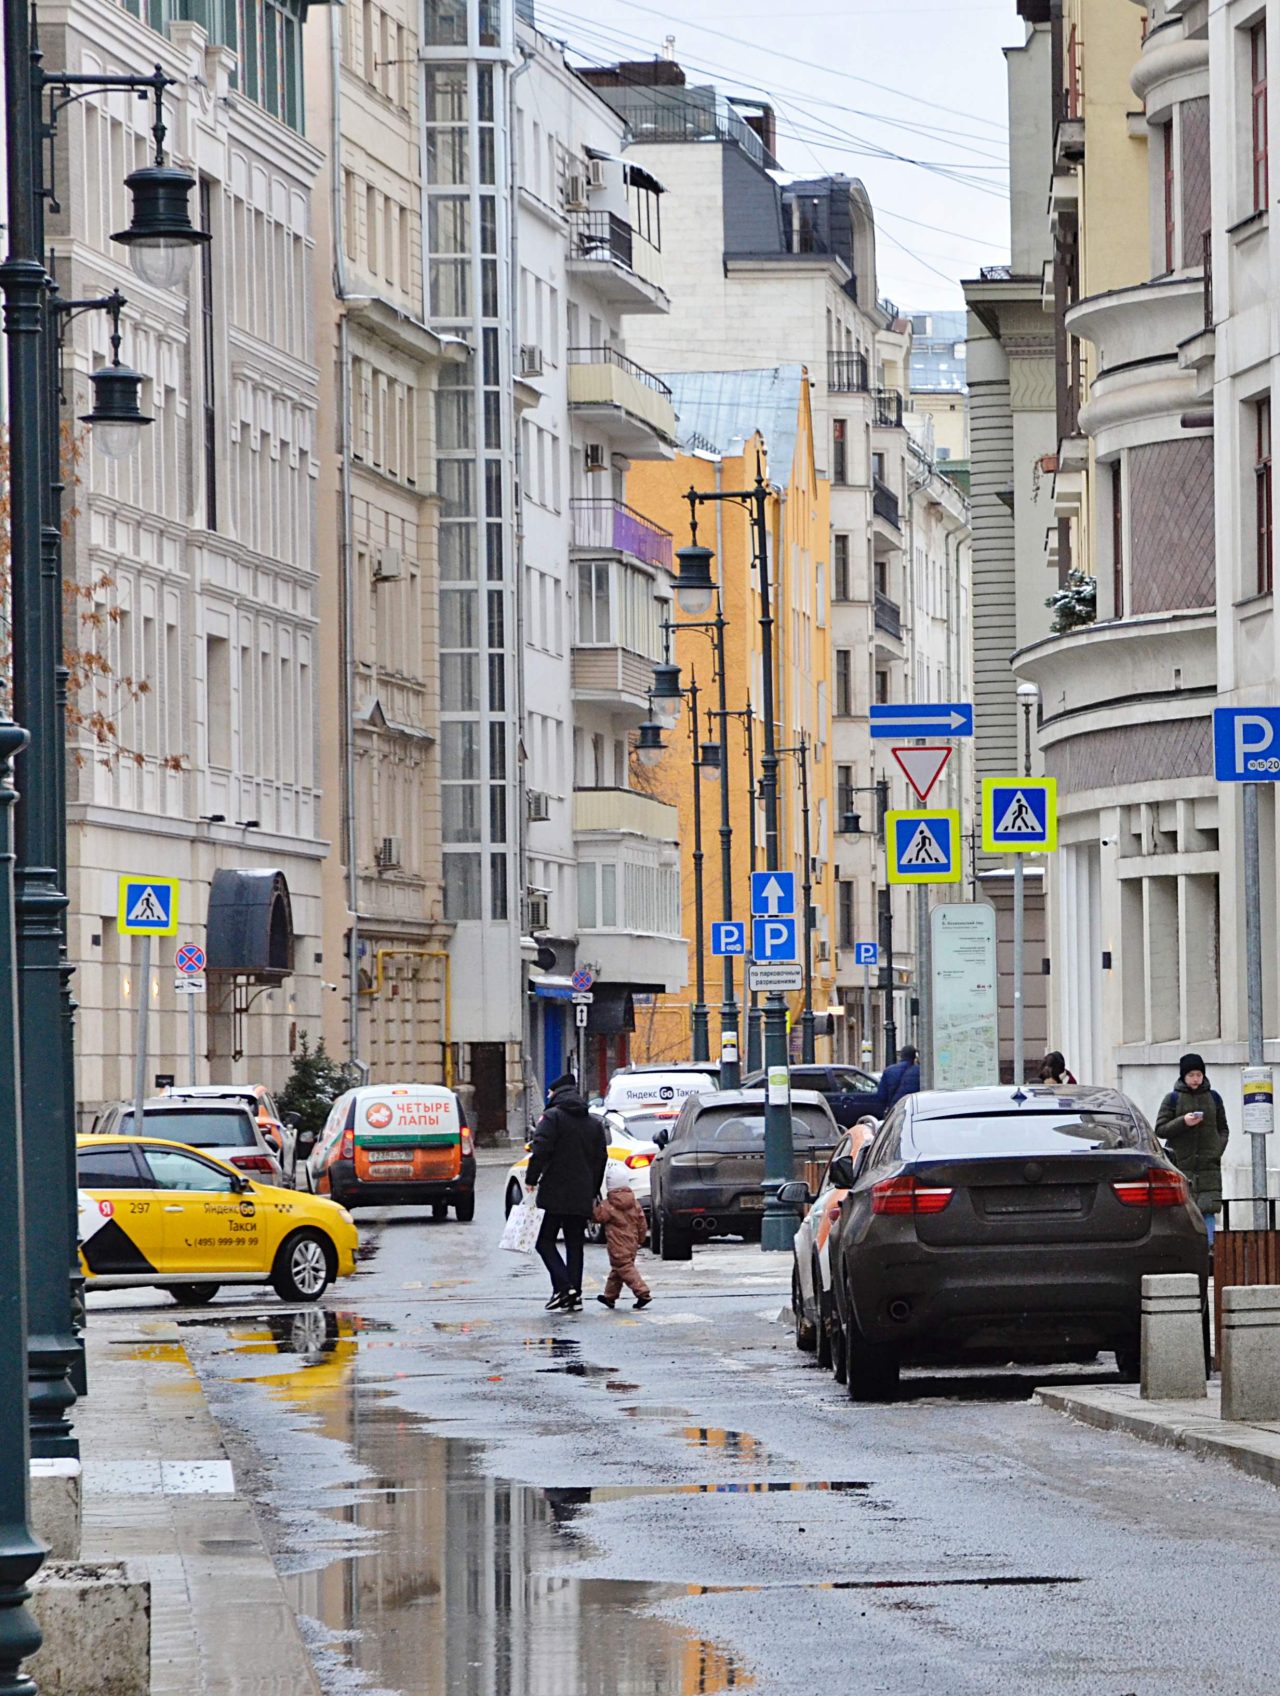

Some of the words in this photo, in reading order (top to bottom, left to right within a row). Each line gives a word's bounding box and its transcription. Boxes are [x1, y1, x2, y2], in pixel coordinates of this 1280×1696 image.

[1234, 715, 1274, 774] P
[1267, 760, 1280, 769] 20
[720, 925, 739, 952] P
[765, 922, 789, 957] P
[860, 944, 874, 963] P
[759, 970, 801, 978] парковочным
[626, 1090, 657, 1100] Яндекс
[660, 1089, 673, 1099] Go
[396, 1102, 450, 1113] ЧЕТЫРЕ
[398, 1115, 439, 1126] ЛАПЫ
[101, 1201, 111, 1215] Я
[130, 1203, 151, 1213] 297
[203, 1202, 240, 1215] Яндекс
[240, 1203, 255, 1215] Go
[228, 1219, 257, 1232] Такси
[194, 1237, 216, 1248] (495)
